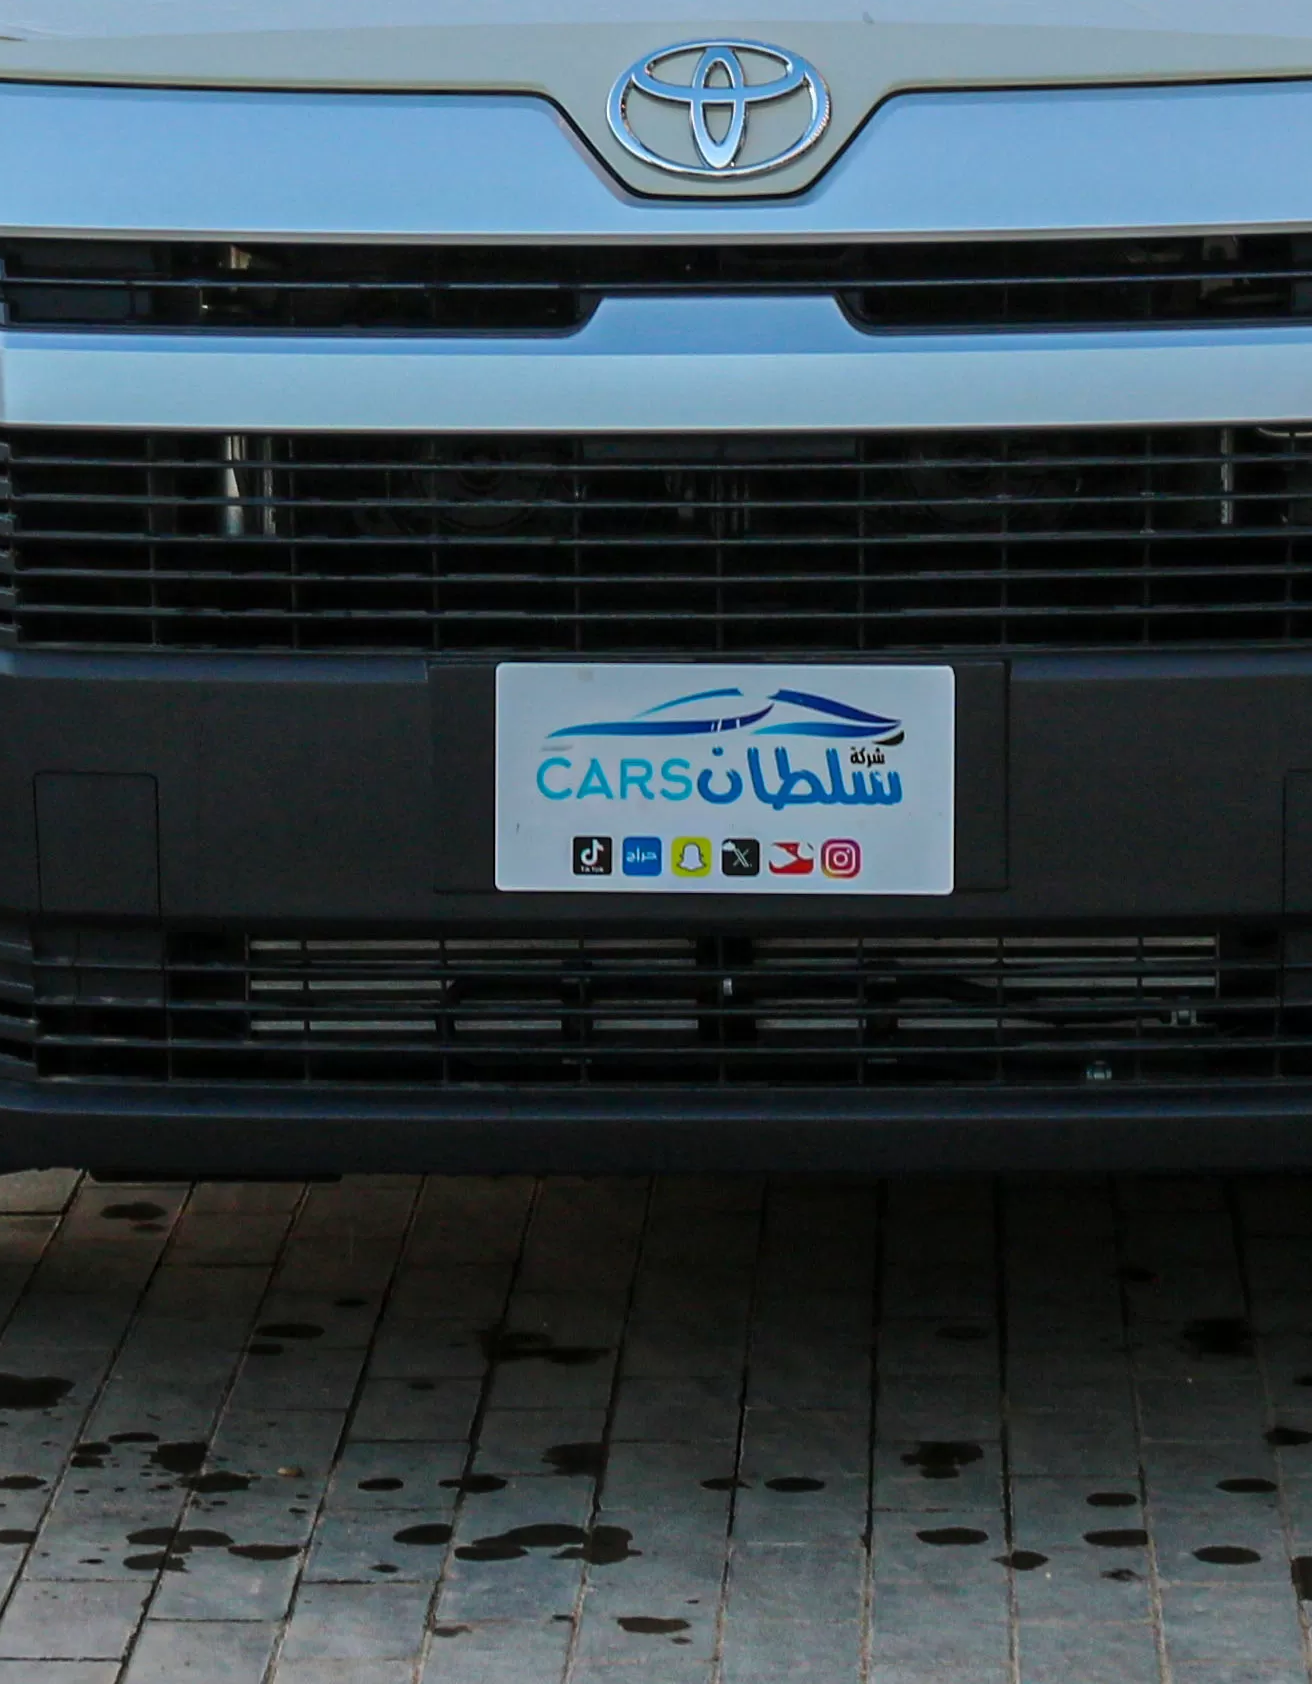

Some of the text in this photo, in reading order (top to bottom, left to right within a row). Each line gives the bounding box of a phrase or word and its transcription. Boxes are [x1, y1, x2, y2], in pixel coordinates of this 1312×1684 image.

[696, 746, 904, 810] سلطان
[850, 746, 886, 767] شركة
[536, 757, 693, 801] CARS
